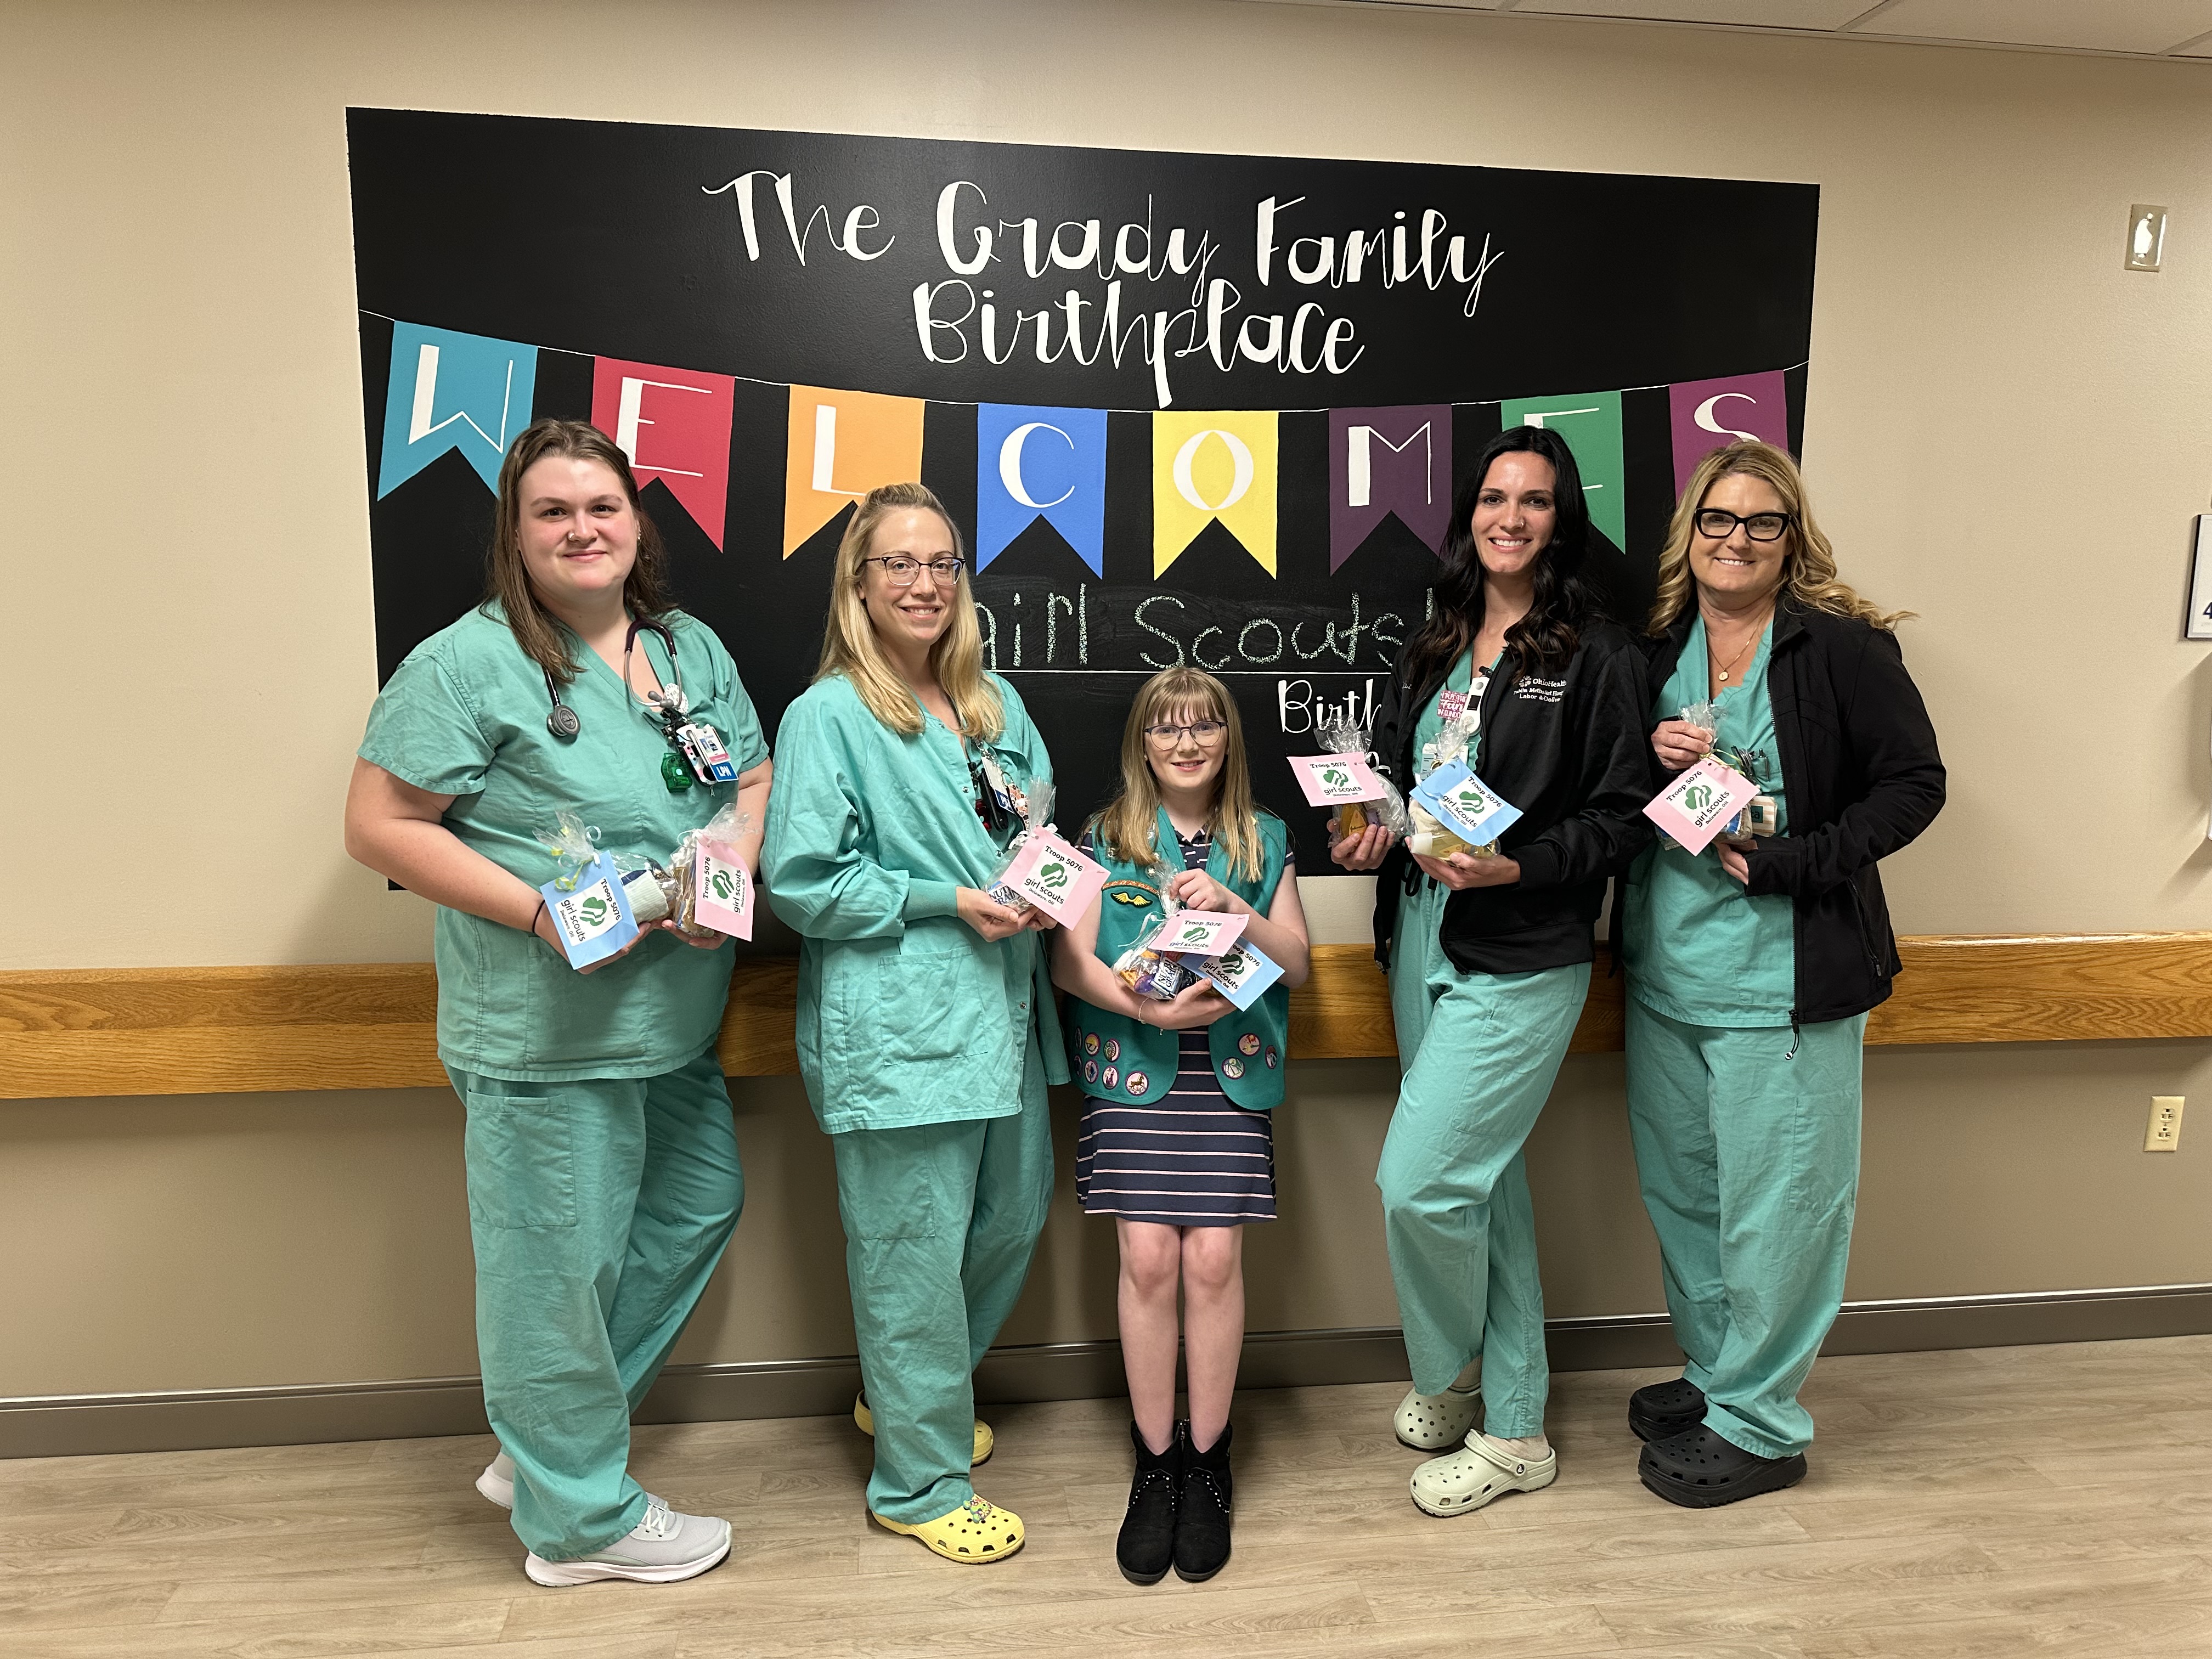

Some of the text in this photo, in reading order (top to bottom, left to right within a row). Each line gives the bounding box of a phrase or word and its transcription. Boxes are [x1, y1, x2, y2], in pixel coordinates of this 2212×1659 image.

[702, 170, 1504, 317] The Grady Family
[913, 278, 1365, 409] Birthplace
[1278, 678, 1382, 733] Birth
[716, 765, 732, 777] LPN
[1666, 770, 1702, 802] Troop 5076
[1324, 786, 1338, 795] girl
[1468, 776, 1502, 808] Troop 5076
[1443, 795, 1477, 827] girl scouts
[1695, 791, 1730, 828] girl scouts
[1045, 845, 1084, 872] Troop 5076
[601, 878, 620, 921] Troop 5076
[1024, 878, 1064, 904] girl scouts
[561, 900, 585, 941] girl scouts
[1232, 944, 1261, 967] oop 5076
[1202, 962, 1239, 990] girl scouts
